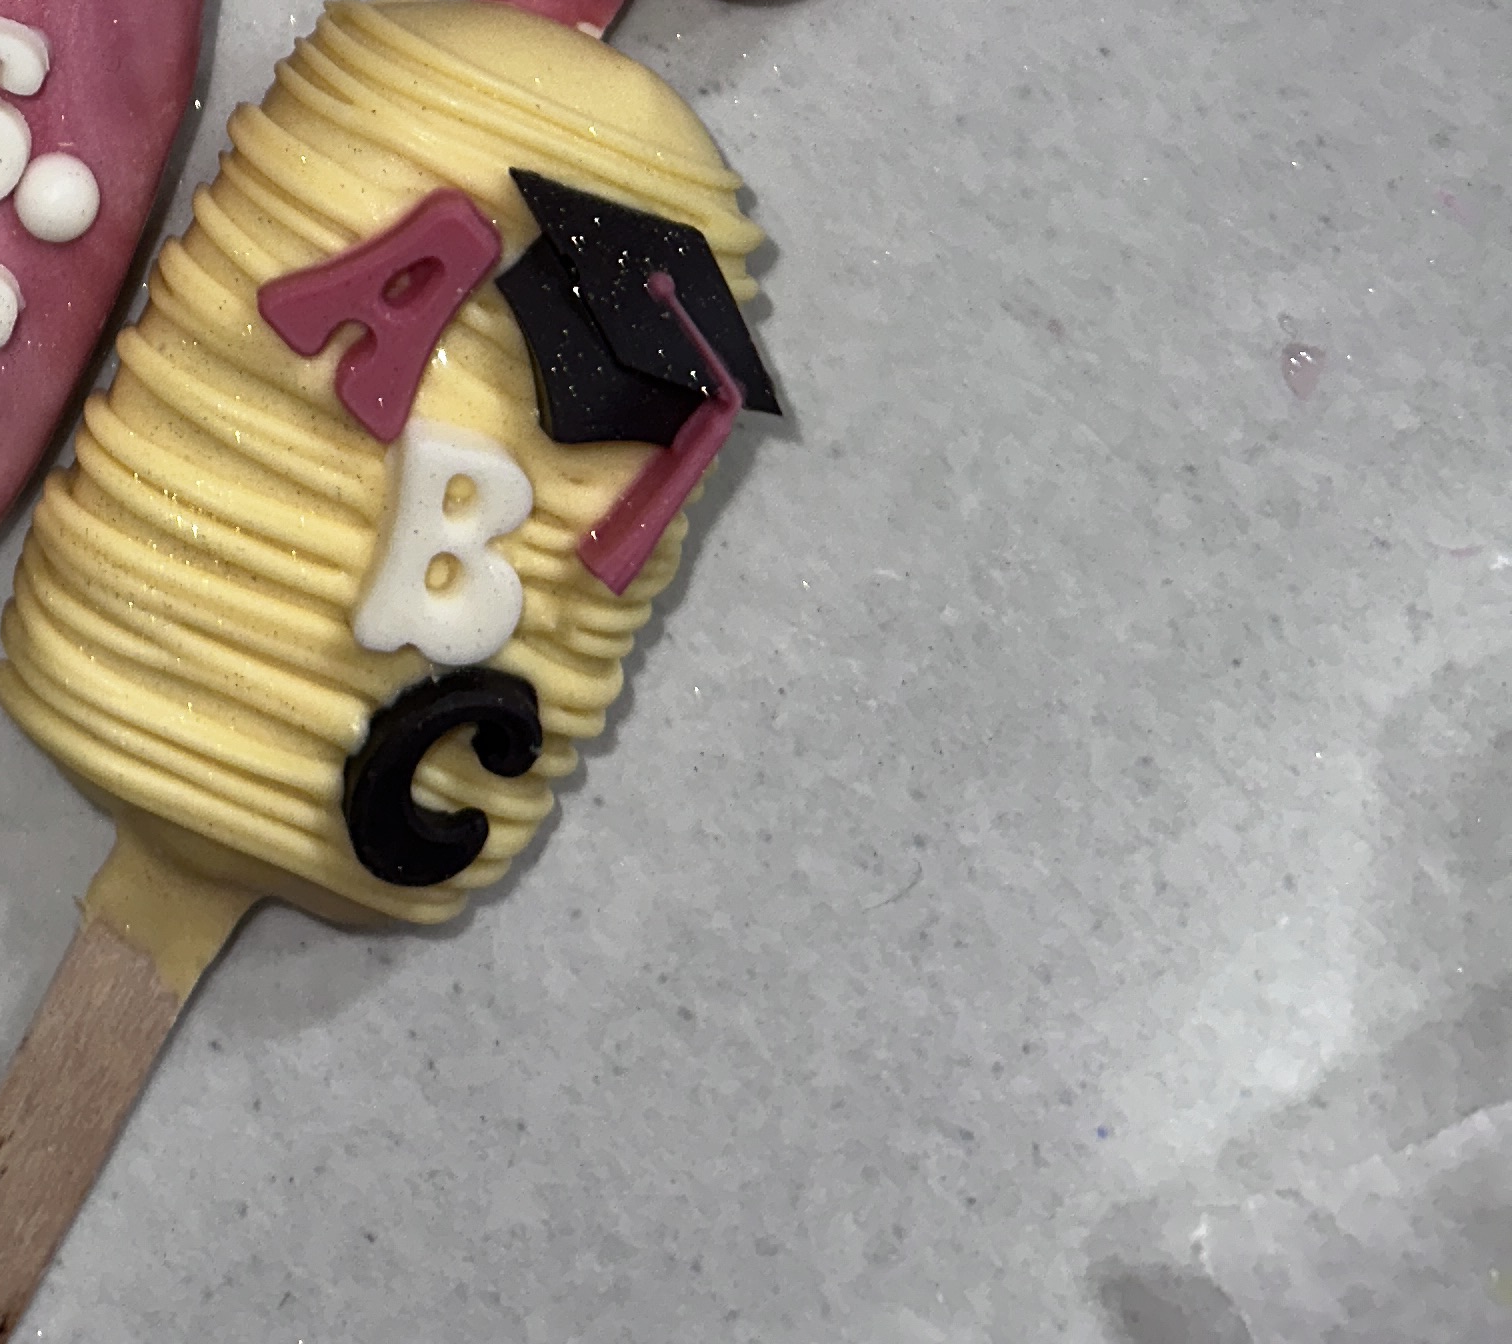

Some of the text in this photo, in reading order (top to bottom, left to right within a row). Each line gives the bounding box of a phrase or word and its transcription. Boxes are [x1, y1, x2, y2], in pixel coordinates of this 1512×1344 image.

[257, 187, 502, 443] A
[353, 419, 534, 665] B
[343, 666, 543, 887] C
